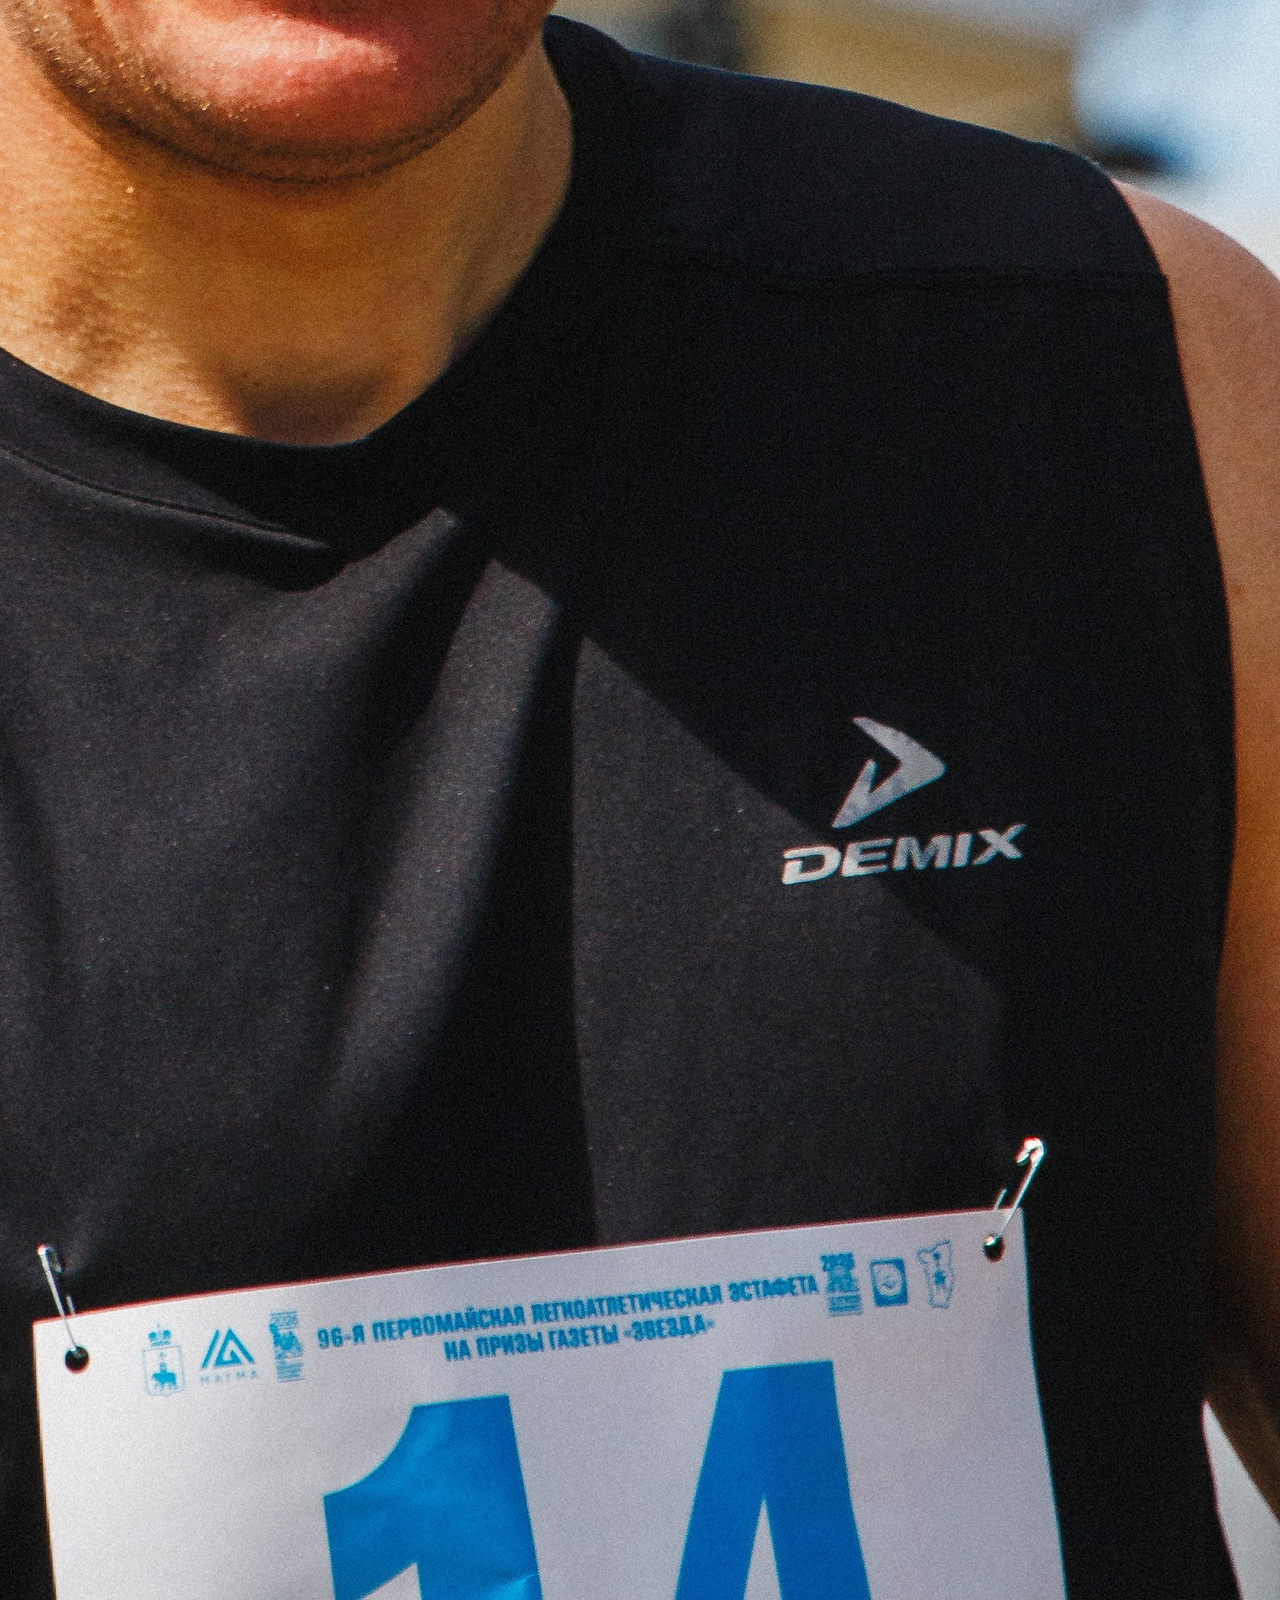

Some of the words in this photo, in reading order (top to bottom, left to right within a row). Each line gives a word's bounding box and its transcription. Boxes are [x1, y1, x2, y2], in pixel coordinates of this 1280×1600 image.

[782, 823, 1026, 885] DEMIX
[317, 1323, 365, 1349] 96-Я
[372, 1304, 526, 1342] ПЕРВОМАЙСКАЯ
[531, 1284, 722, 1323] ЛЕГКОАТЛЕТИЧЕСКАЯ
[728, 1274, 818, 1302] ЭСТАФЕТА
[443, 1338, 471, 1362] НА
[475, 1331, 544, 1358] ПРИЗЫ
[548, 1324, 619, 1350] ГАЗЕТЫ
